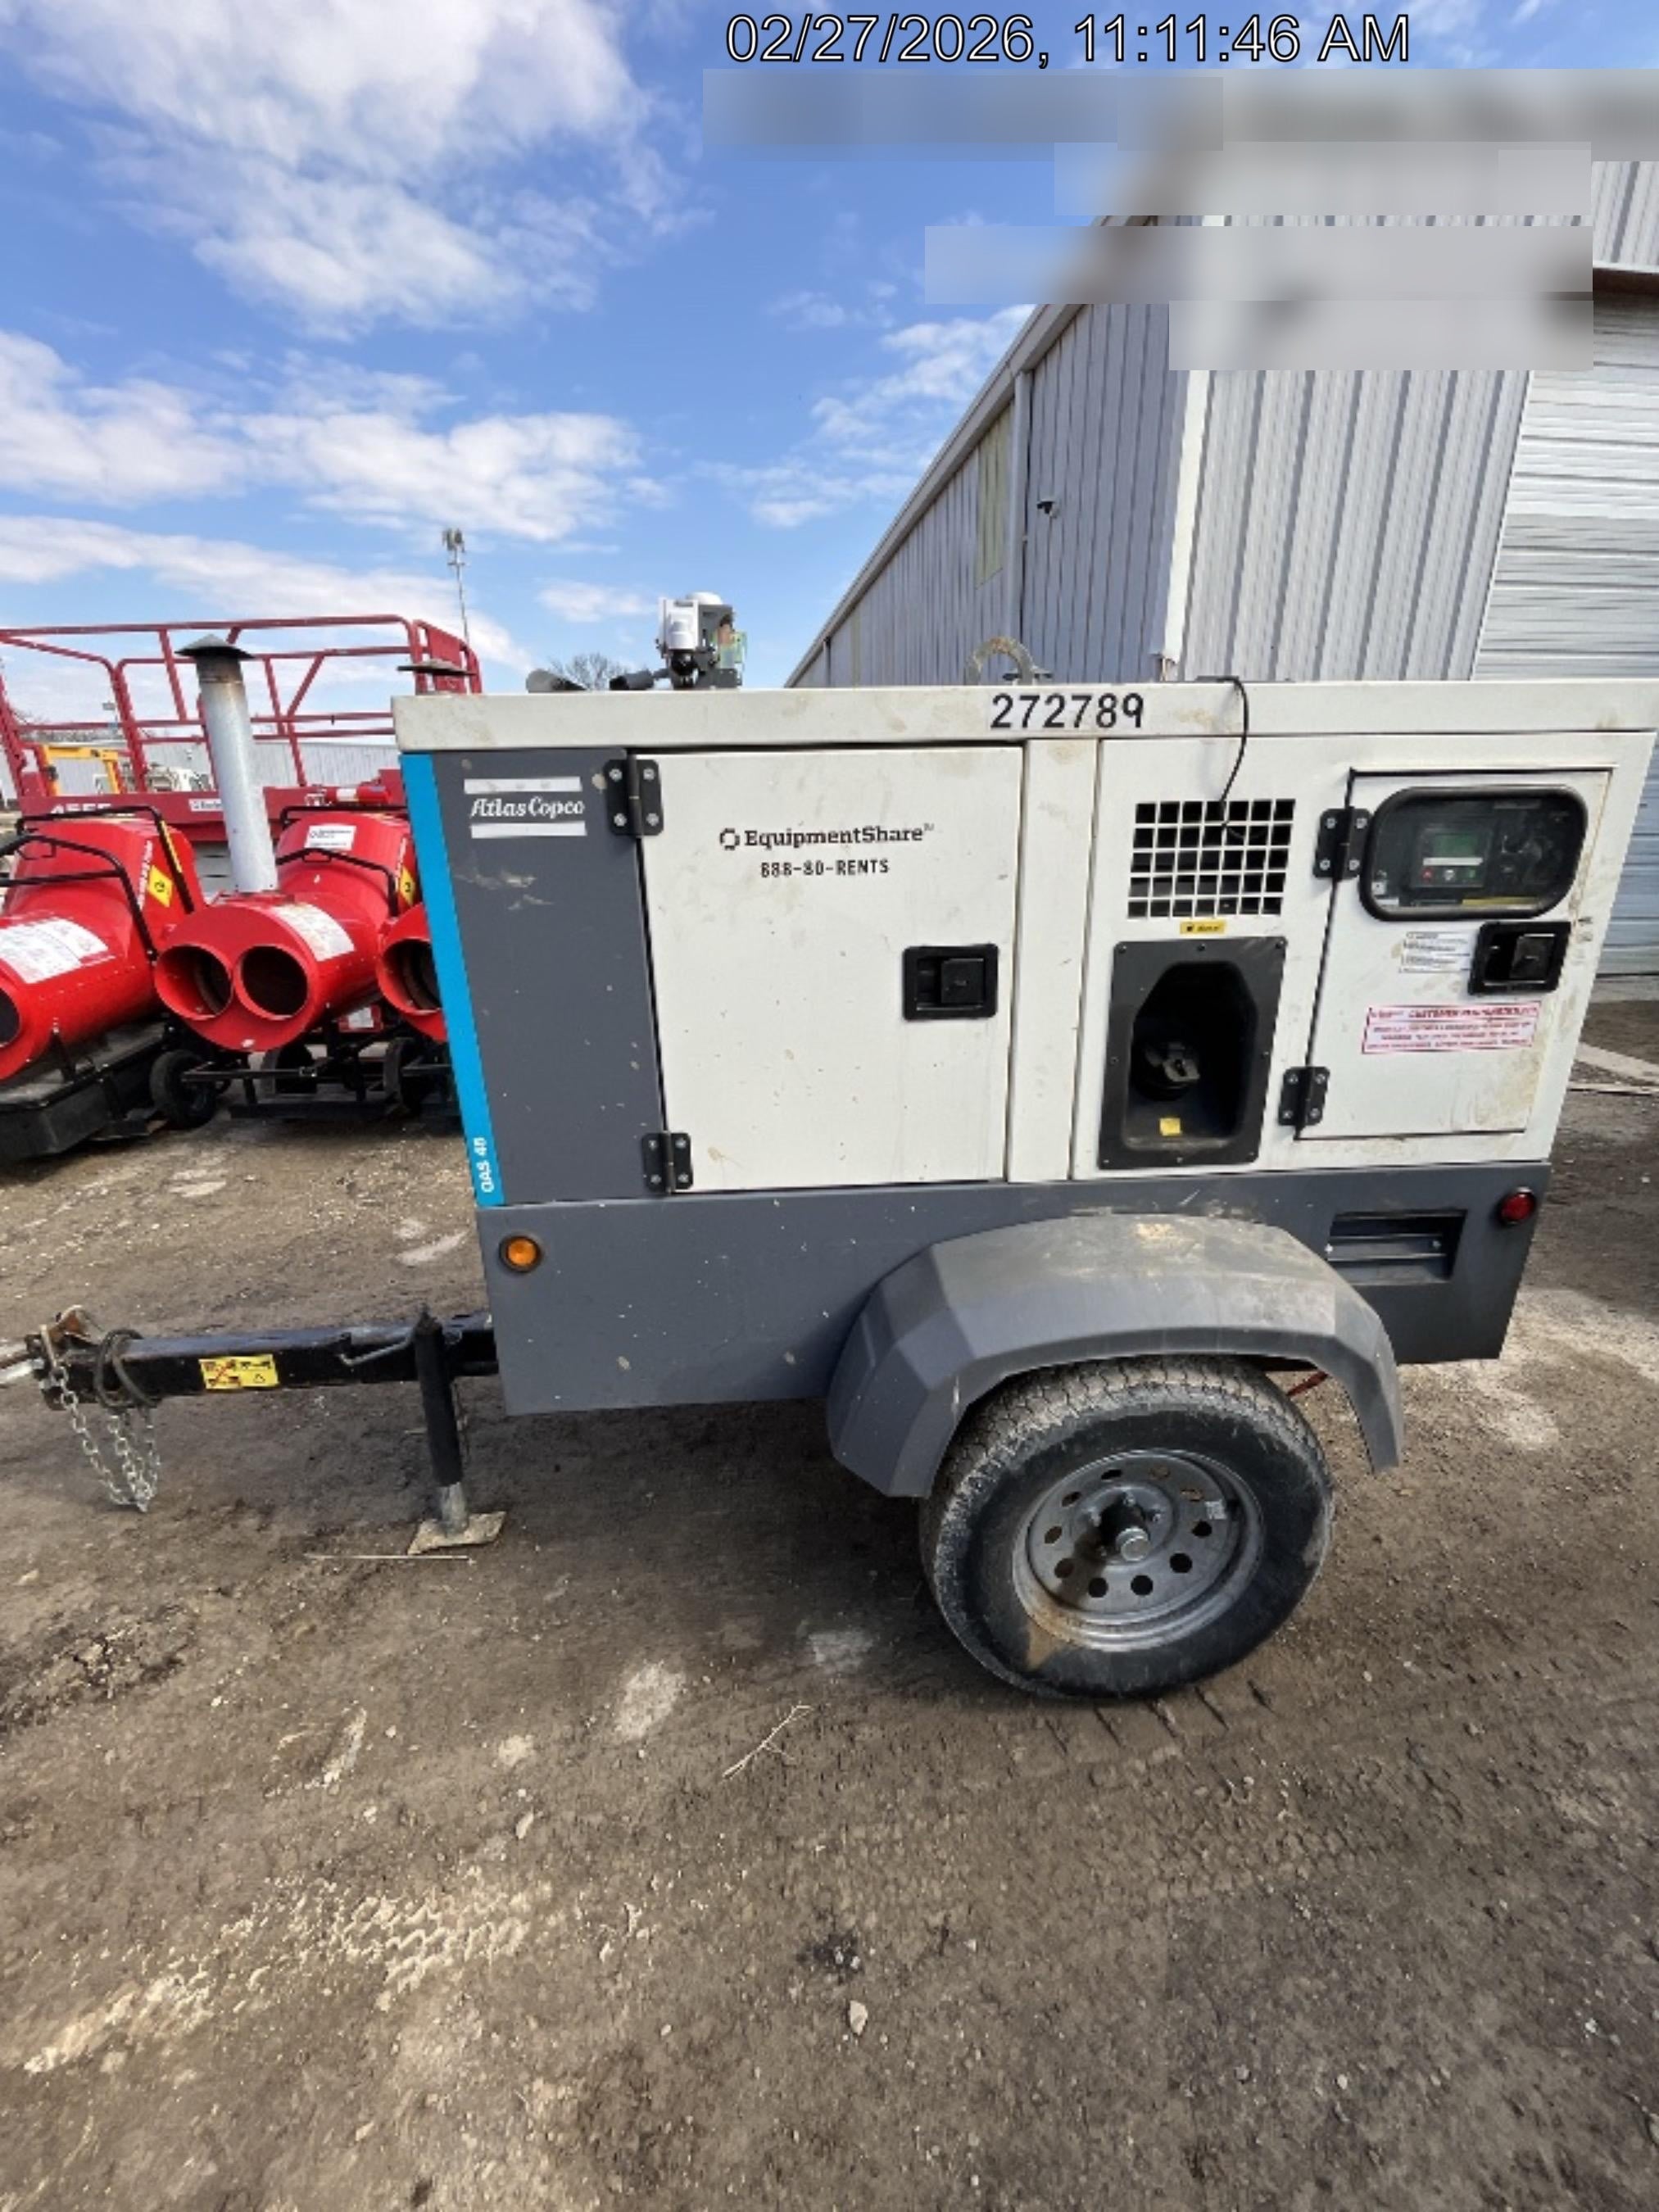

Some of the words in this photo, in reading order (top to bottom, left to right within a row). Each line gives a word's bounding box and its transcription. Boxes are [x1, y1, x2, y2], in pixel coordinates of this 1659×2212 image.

[990, 692, 1144, 729] 272789
[469, 798, 526, 818] Atlas
[528, 796, 585, 819] Copco
[744, 825, 923, 850] EquipmentShare
[759, 858, 891, 879] 888-80-RENTS
